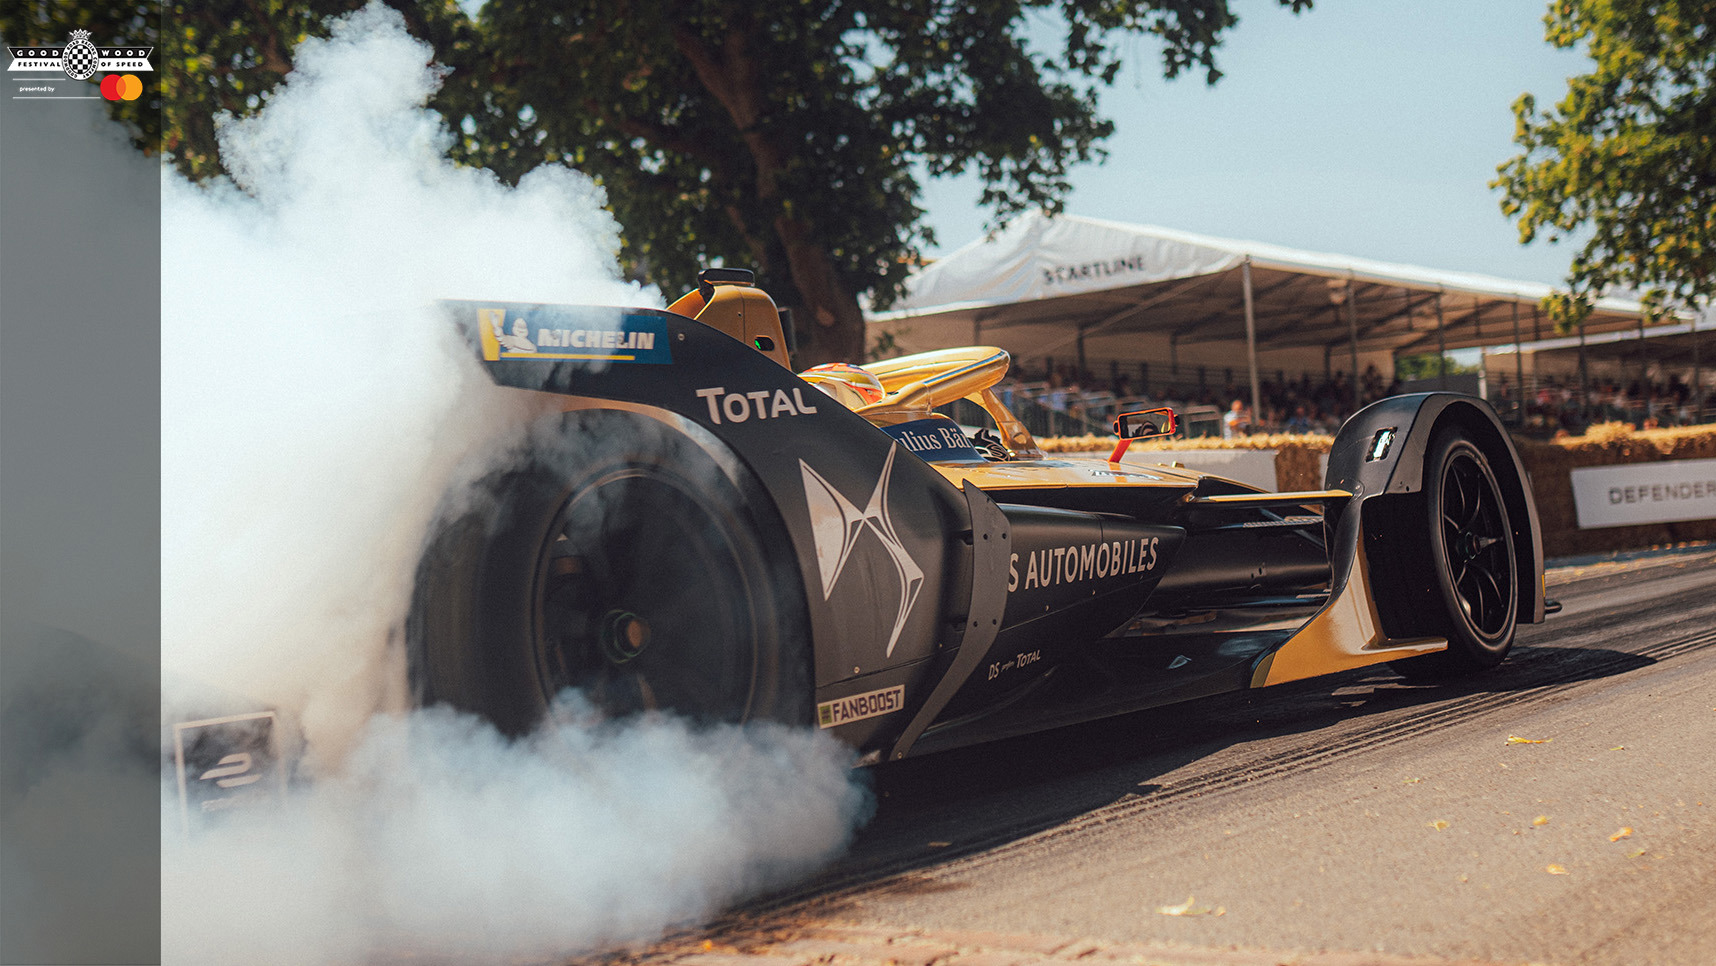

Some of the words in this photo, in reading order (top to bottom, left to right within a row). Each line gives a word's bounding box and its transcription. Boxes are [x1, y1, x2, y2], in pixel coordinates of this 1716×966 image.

[1043, 256, 1144, 285] STARTLINE
[537, 328, 655, 350] MICHELIN
[696, 387, 817, 425] TOTAL
[896, 431, 942, 452] ulius
[1609, 480, 1716, 504] DEFENDER
[1008, 552, 1019, 593] S
[1024, 536, 1159, 590] AUTOMOBILES
[988, 661, 1000, 680] DS
[832, 689, 901, 722] FANBOOST
